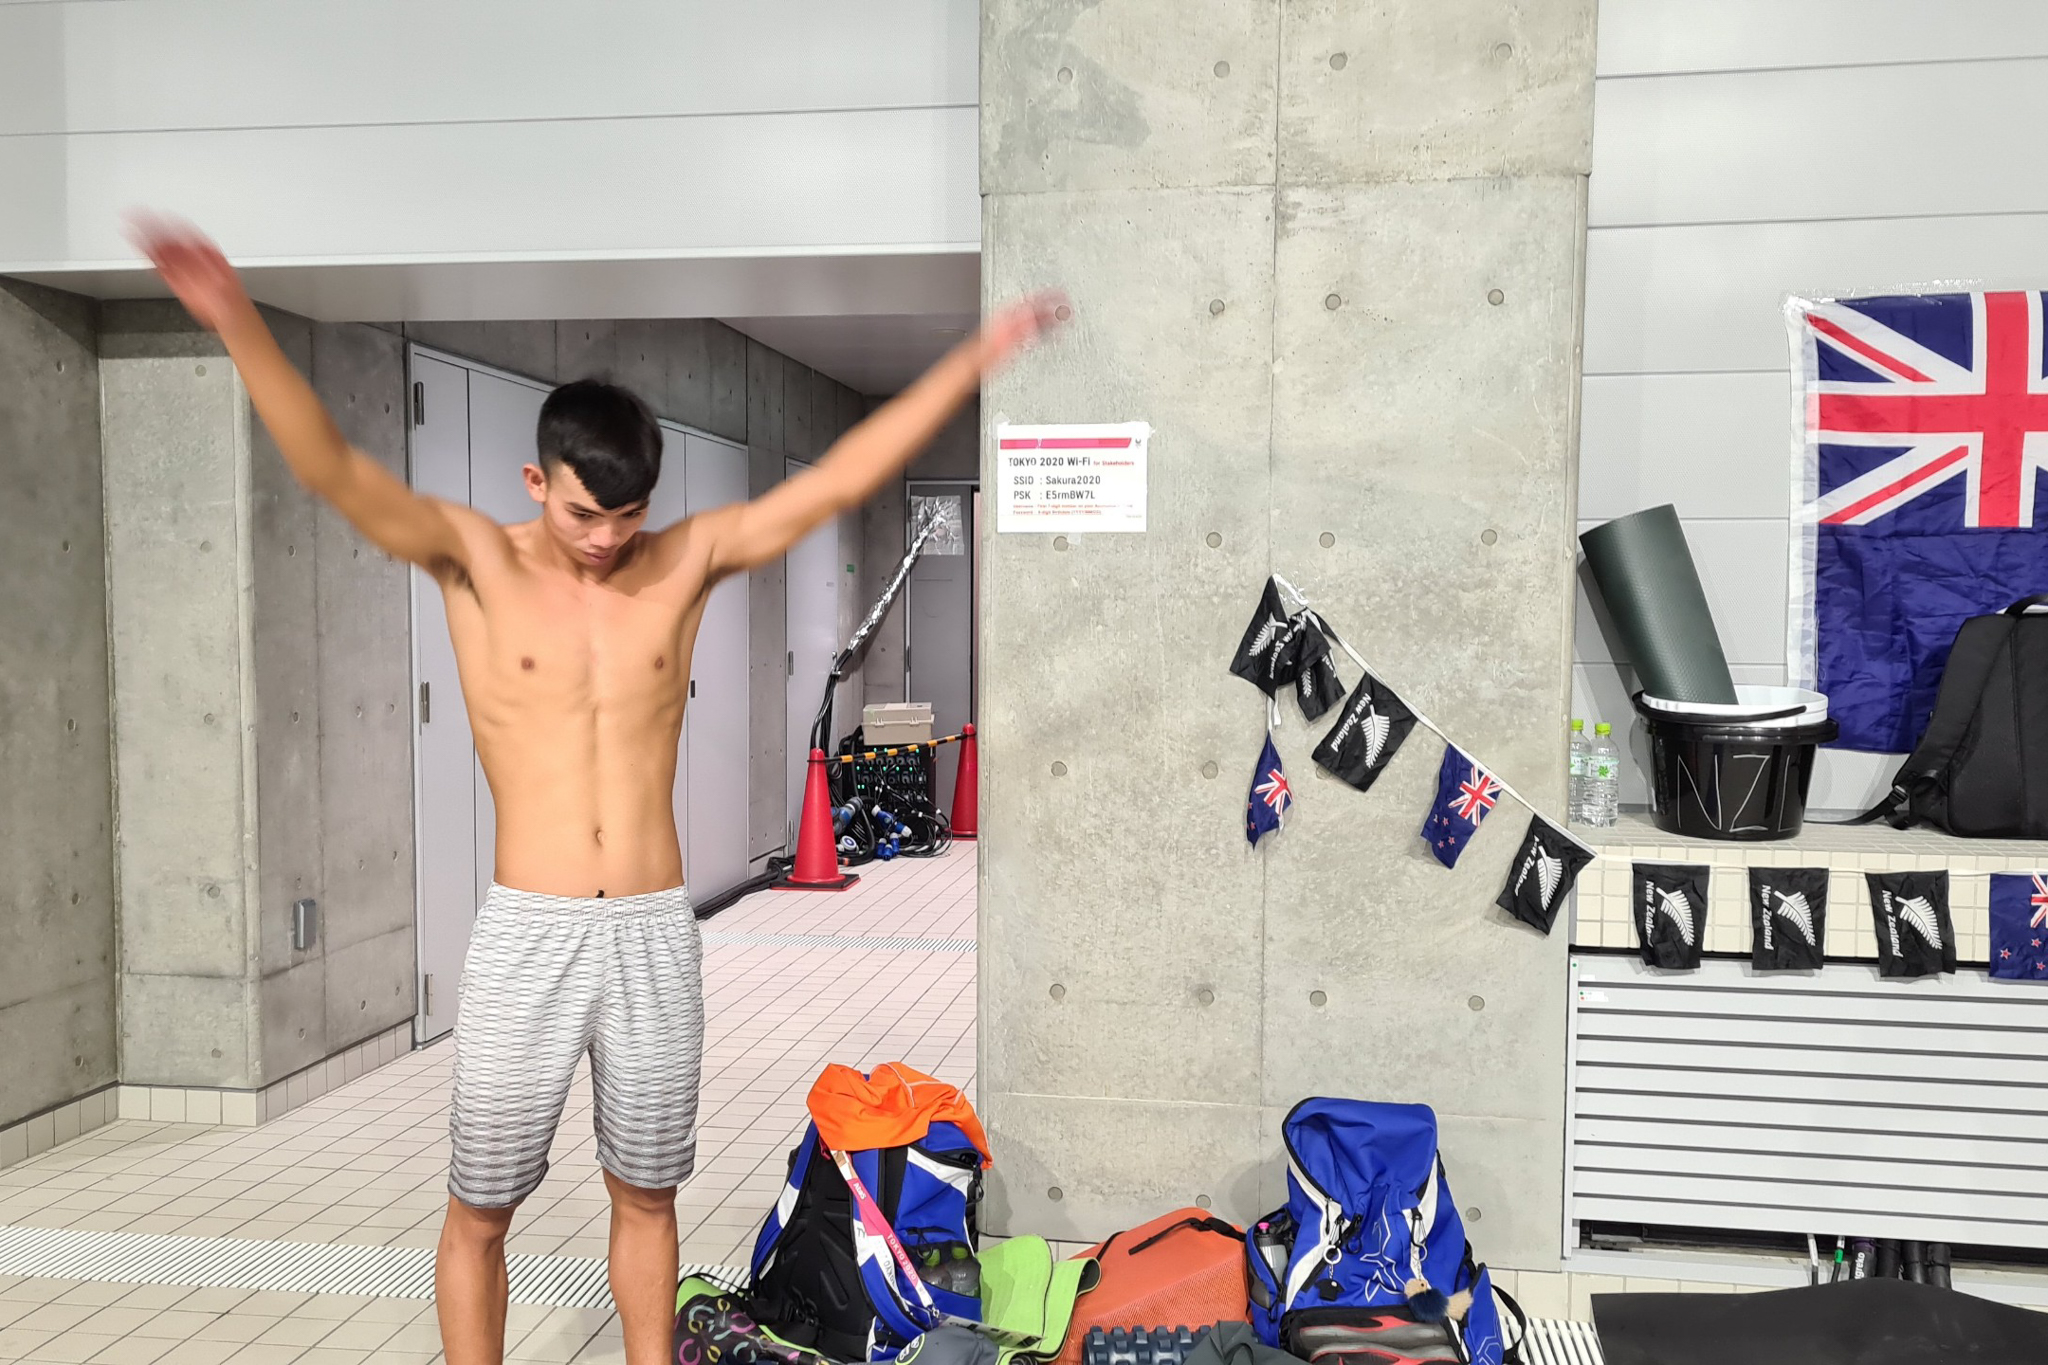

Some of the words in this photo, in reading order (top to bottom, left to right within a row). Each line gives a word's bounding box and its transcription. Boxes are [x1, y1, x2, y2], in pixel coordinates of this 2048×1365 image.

[1008, 457, 1037, 467] TOKYO
[1040, 457, 1064, 467] 2020
[1067, 457, 1091, 466] Wi-Fi
[1013, 475, 1034, 485] SSID
[1046, 475, 1101, 485] Sakura2020
[1013, 490, 1031, 500] PSK
[1046, 490, 1095, 500] E5rmBW7L
[1355, 693, 1372, 715] New
[1330, 713, 1359, 753] Zealand
[1677, 754, 1799, 833] NZL
[1645, 880, 1655, 904] New
[1761, 884, 1771, 908] New
[1882, 889, 1893, 913] New
[1762, 907, 1774, 951] Zealand
[1887, 914, 1904, 958] Zealand
[887, 1233, 905, 1260] TOKYO
[902, 1260, 917, 1280] 2020
